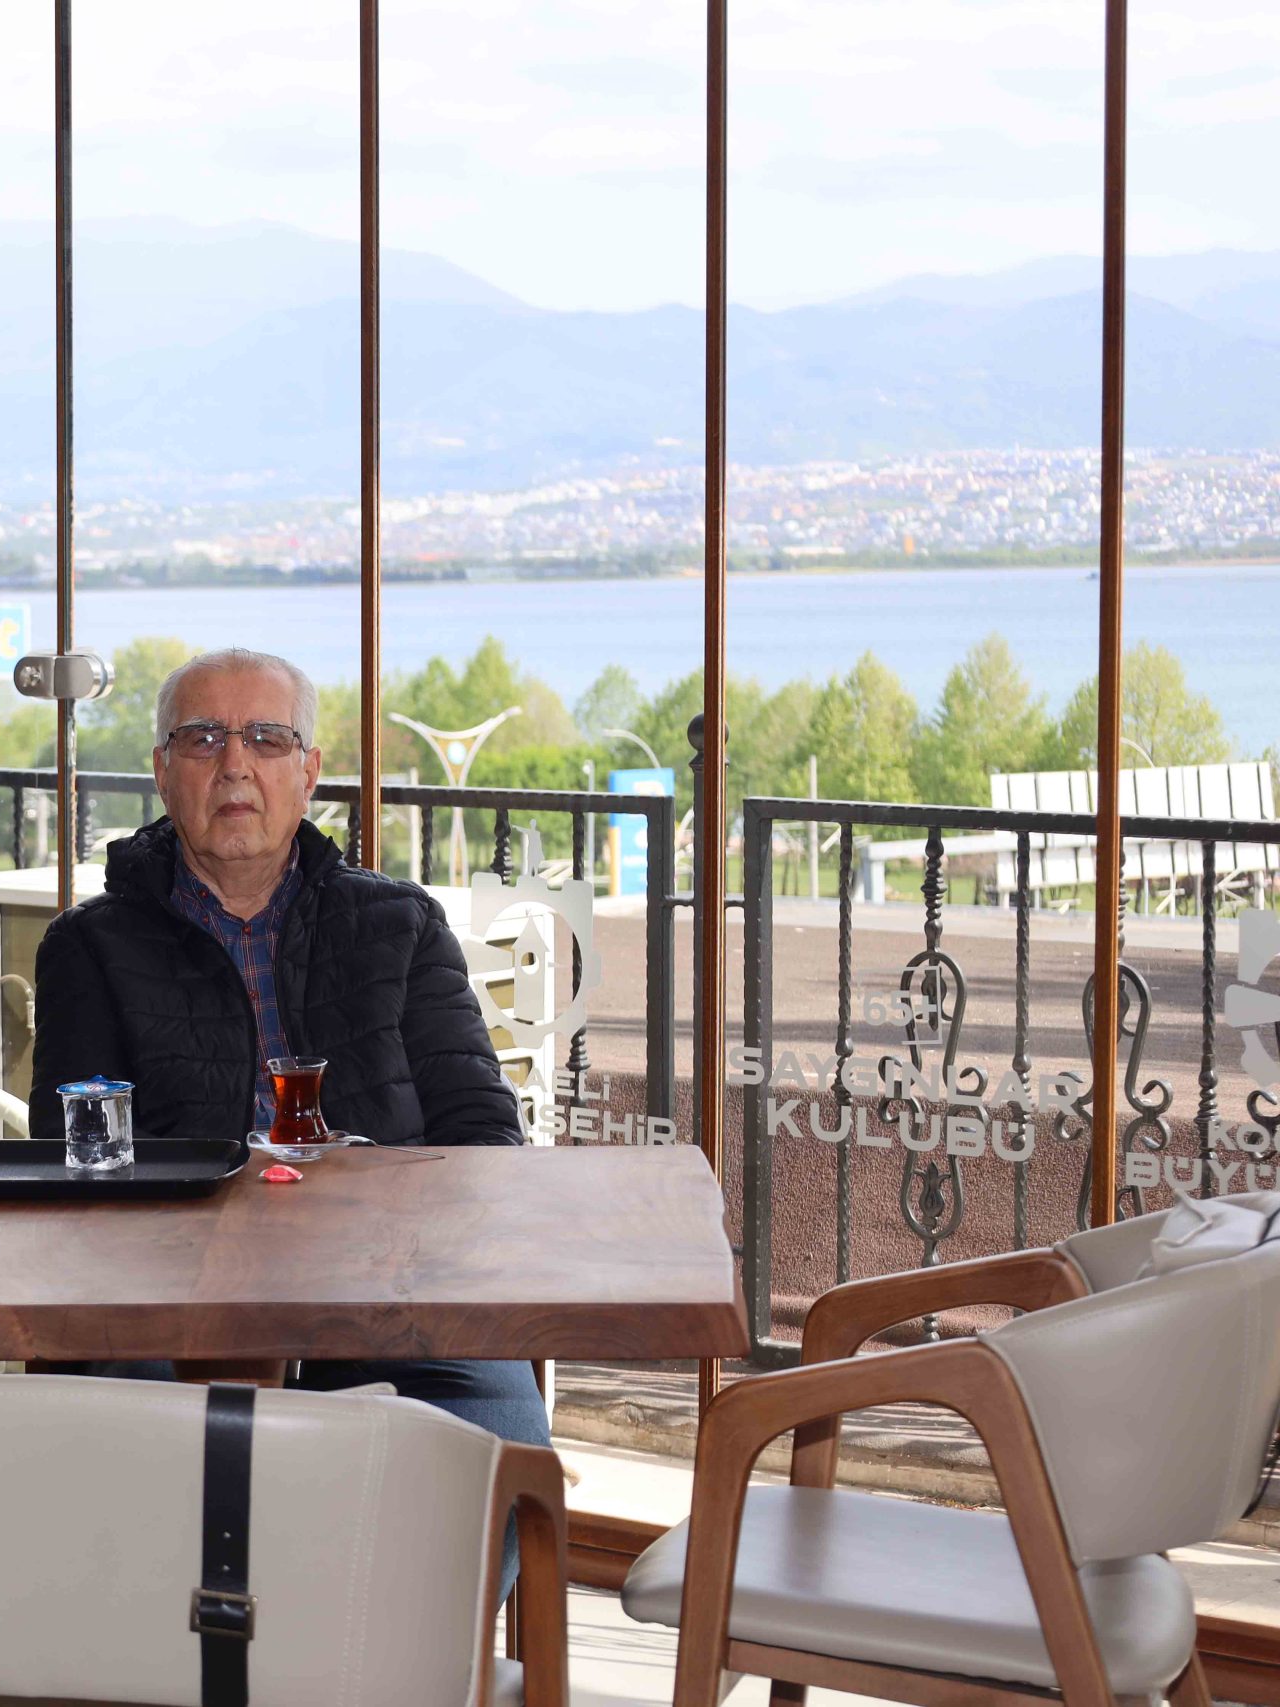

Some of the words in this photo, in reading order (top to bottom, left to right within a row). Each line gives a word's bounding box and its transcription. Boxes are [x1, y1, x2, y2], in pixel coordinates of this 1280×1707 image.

[863, 990, 938, 1027] 65+
[725, 1046, 1080, 1116] SAYGINLAR
[766, 1096, 1036, 1162] KULÜBÜ
[1207, 1118, 1280, 1154] KO
